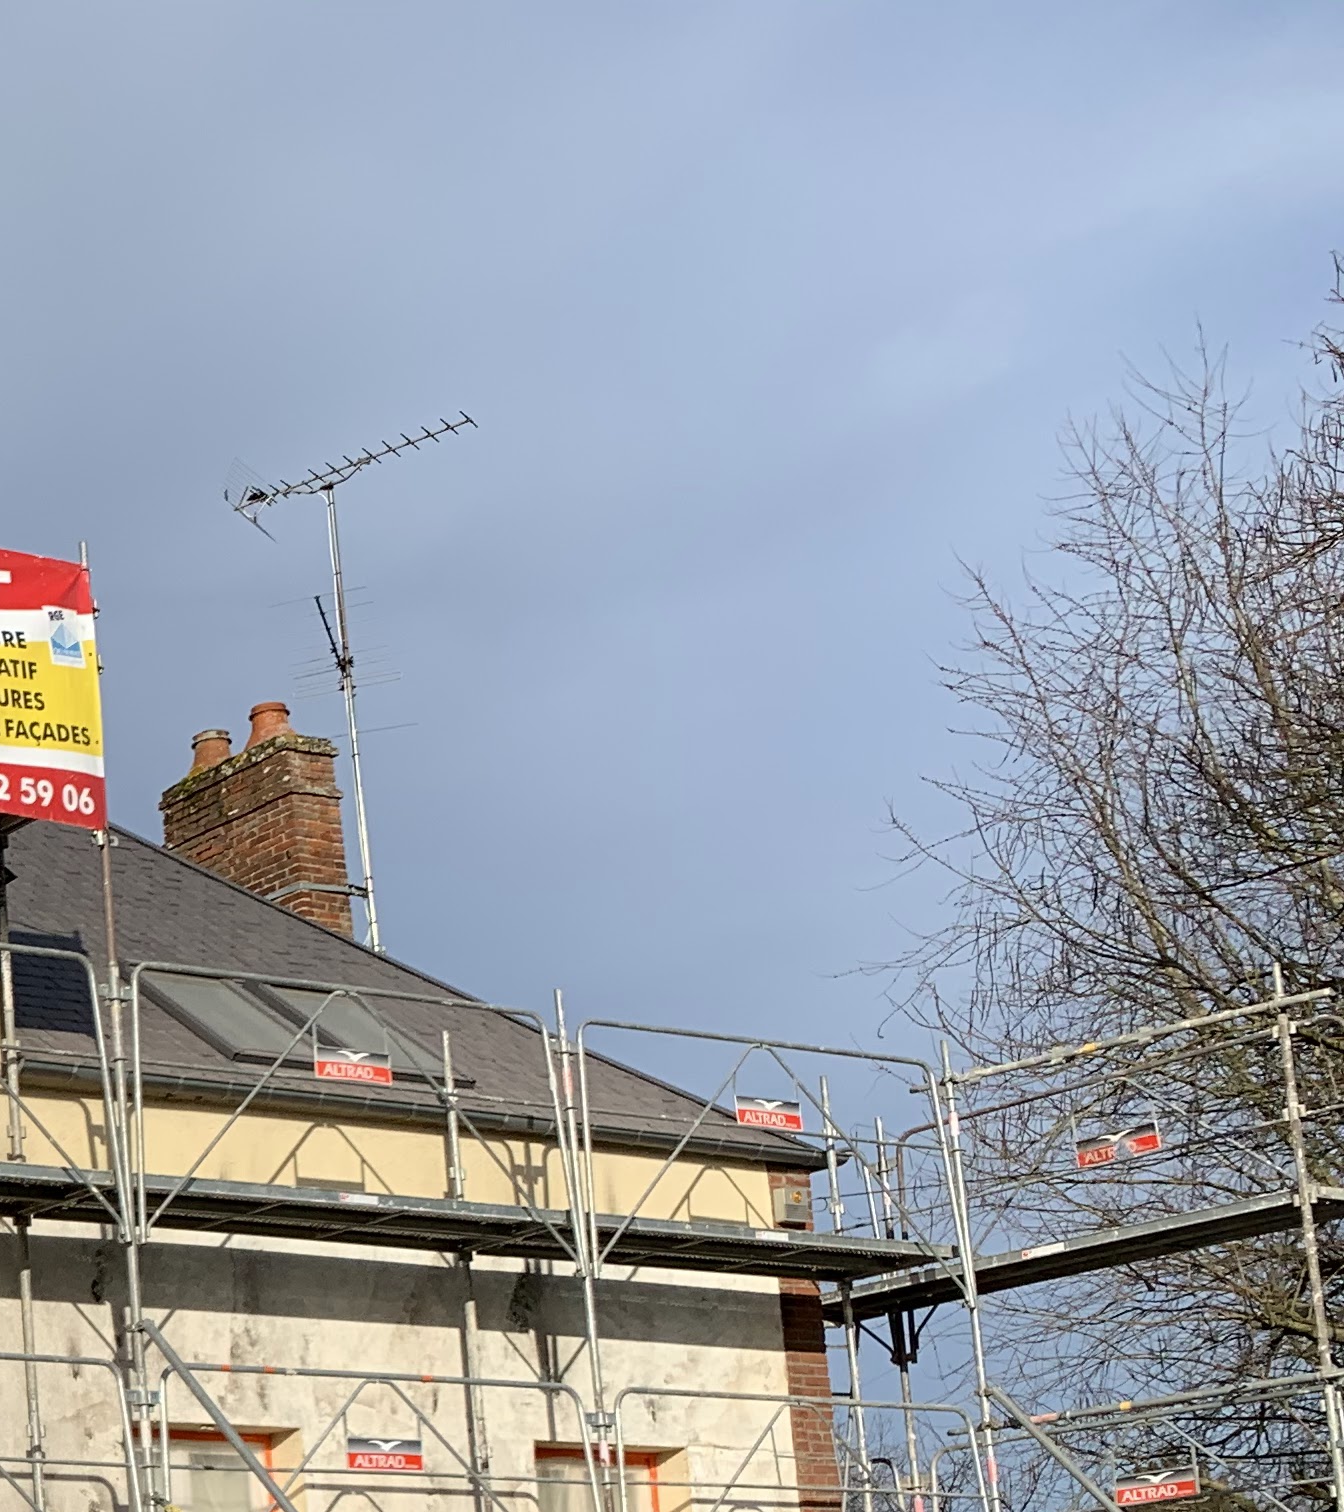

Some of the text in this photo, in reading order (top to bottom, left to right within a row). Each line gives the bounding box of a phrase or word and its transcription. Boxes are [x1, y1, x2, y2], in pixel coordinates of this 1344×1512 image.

[19, 777, 54, 807] 59
[62, 783, 95, 815] 06
[322, 1063, 375, 1079] ALTRAD
[743, 1110, 786, 1127] ALTRAD
[353, 1454, 406, 1469] ALTRAD
[1121, 1484, 1179, 1503] ALTRAD
